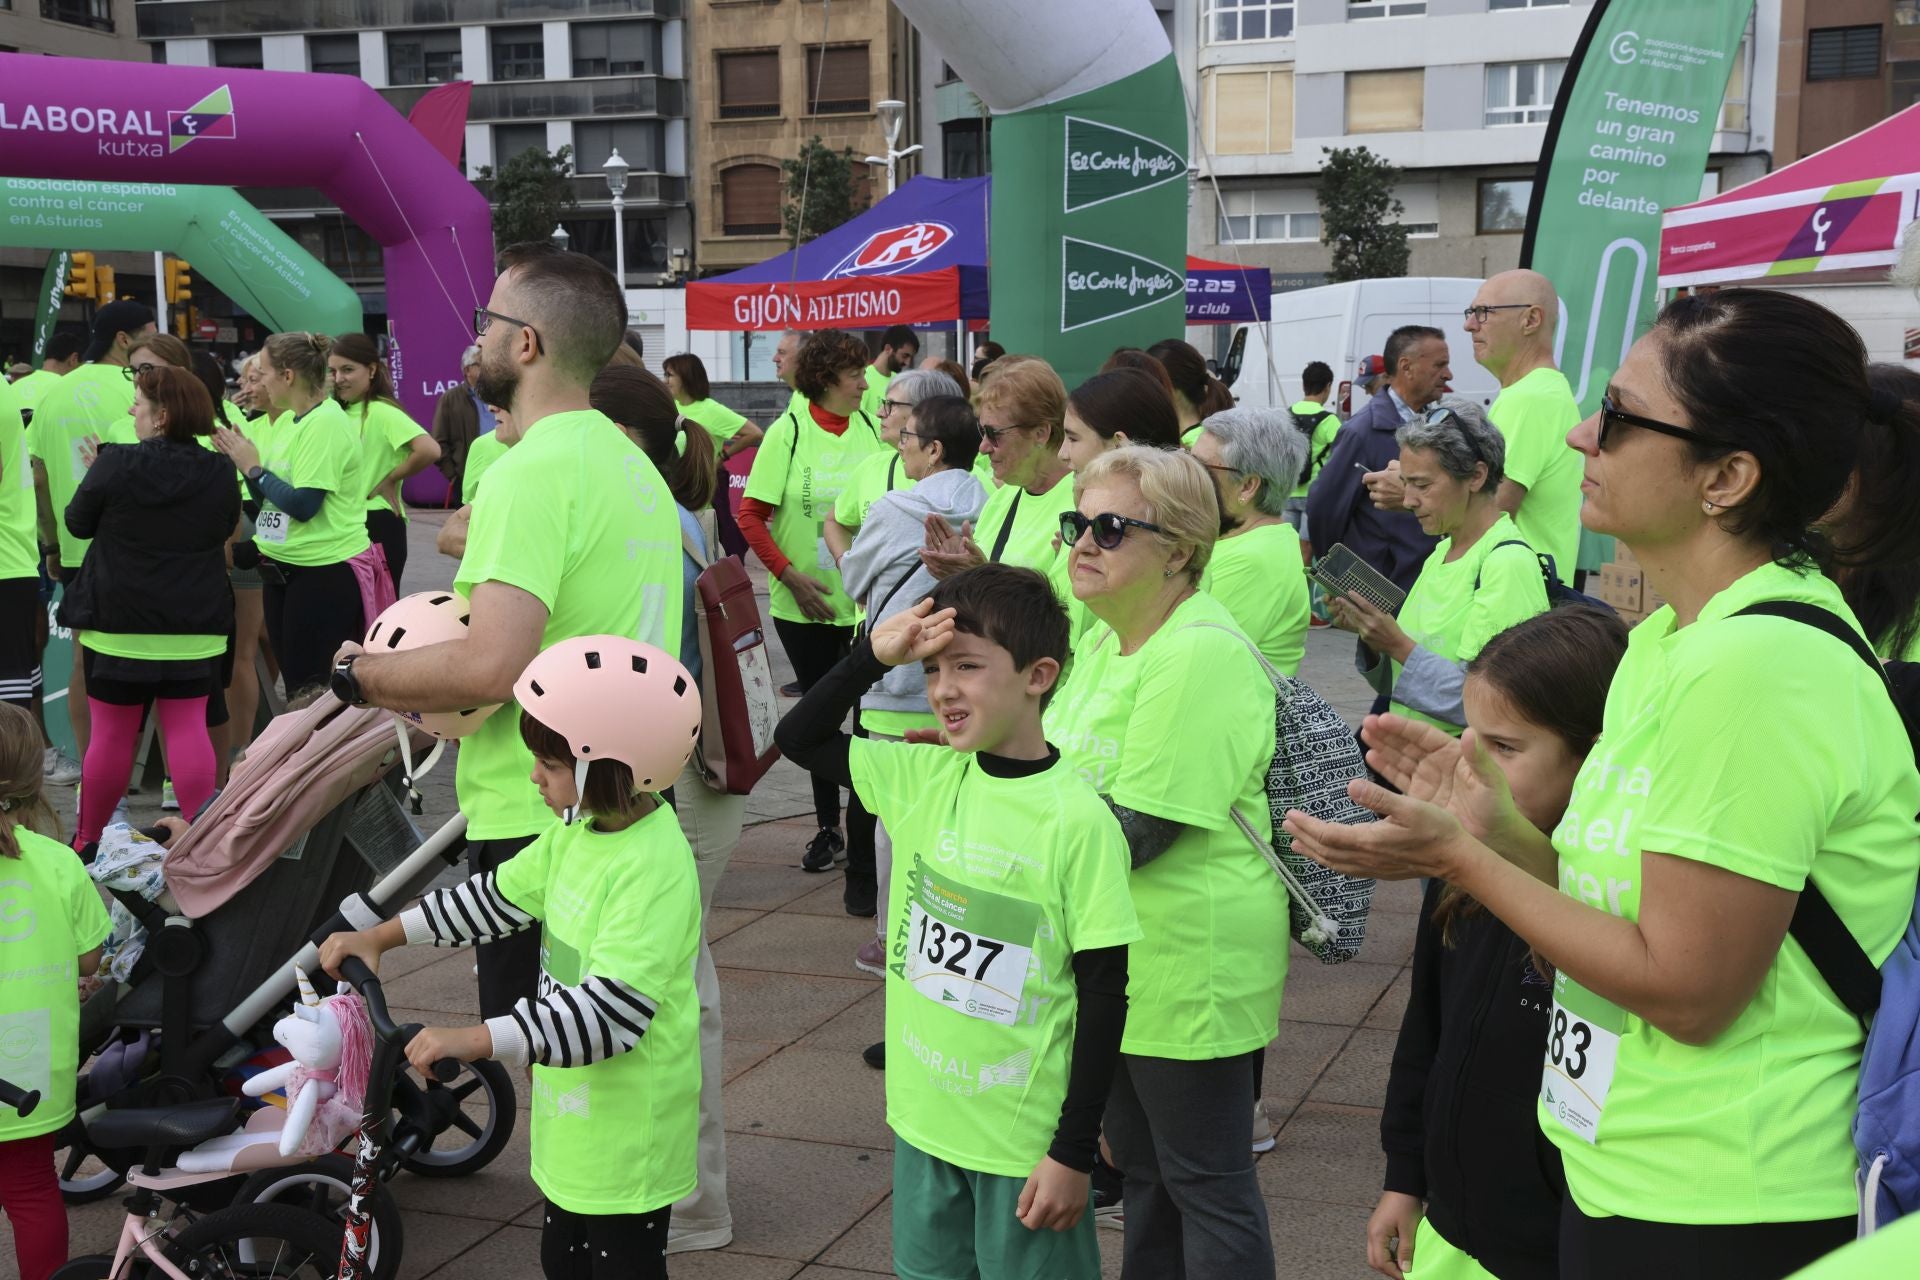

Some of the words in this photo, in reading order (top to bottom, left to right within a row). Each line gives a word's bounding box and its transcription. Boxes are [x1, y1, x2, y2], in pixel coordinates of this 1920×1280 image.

[0, 103, 163, 136] LABORAL
[1605, 91, 1699, 124] Tenemos
[1596, 119, 1622, 136] un
[1625, 124, 1675, 145] gran
[98, 138, 163, 157] kutxa
[1070, 151, 1089, 171] El
[1090, 151, 1130, 170] Corte
[1131, 146, 1175, 177] Inglés
[1589, 144, 1666, 167] camino
[7, 178, 97, 192] asociación
[102, 182, 176, 197] española
[1582, 167, 1620, 185] por
[9, 195, 64, 209] contra
[68, 197, 84, 210] el
[87, 197, 144, 212] cáncer
[1578, 188, 1659, 215] delante
[9, 214, 31, 225] en
[35, 214, 103, 229] Asturias
[220, 220, 231, 231] el
[230, 228, 262, 256] cáncer
[262, 254, 275, 267] en
[274, 265, 311, 297] Asturias
[228, 210, 241, 223] En
[241, 221, 275, 253] marcha
[276, 250, 305, 277] contra
[1068, 271, 1086, 290] El
[1087, 271, 1127, 290] Corte
[1128, 266, 1173, 296] Inglés
[734, 284, 801, 329] GIJÓN
[806, 289, 901, 321] ATLETISMO
[1198, 302, 1230, 315] club
[422, 379, 464, 396] LAB
[802, 466, 811, 519] ASTURIAS
[1585, 808, 1632, 857] el
[919, 914, 1005, 981] 1327
[902, 1023, 974, 1080] LABORAL
[1547, 1008, 1592, 1080] 83
